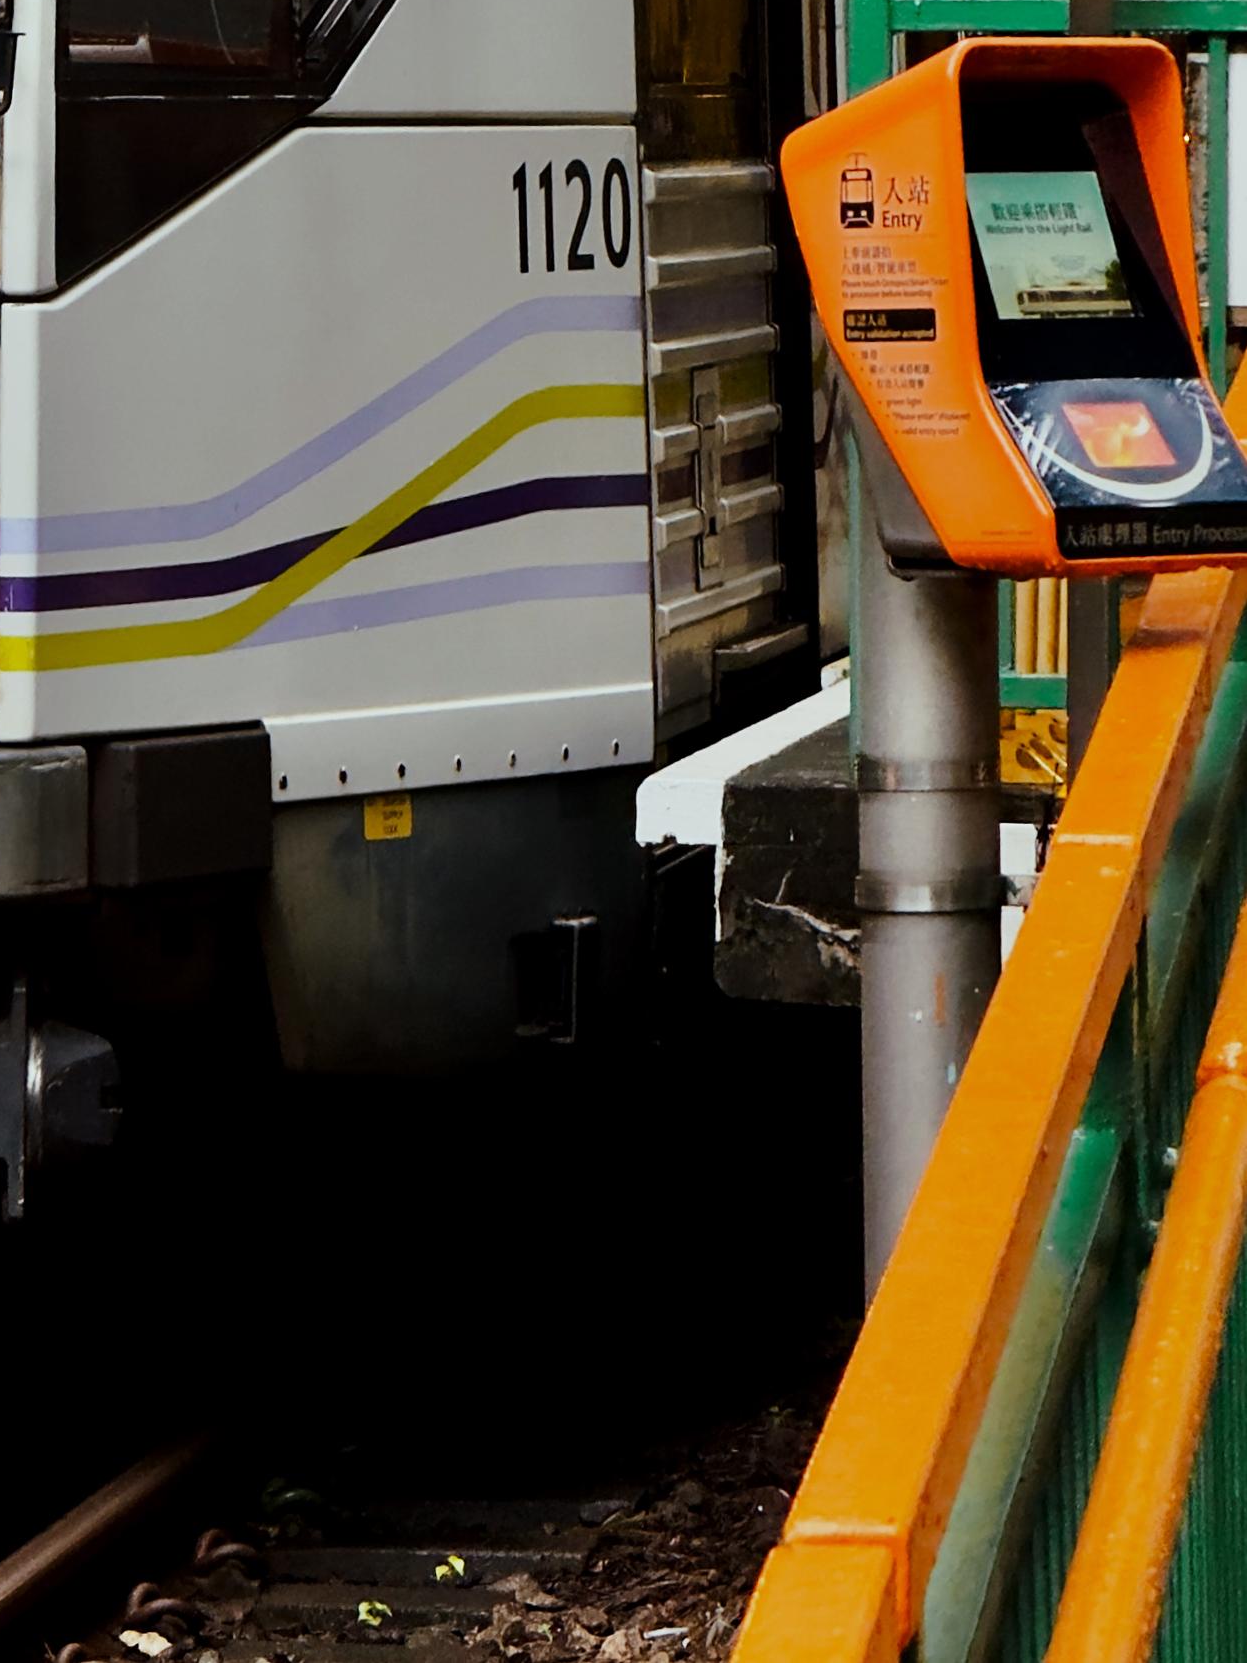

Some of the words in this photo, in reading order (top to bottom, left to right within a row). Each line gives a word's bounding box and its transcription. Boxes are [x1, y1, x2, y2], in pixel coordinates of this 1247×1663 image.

[883, 176, 930, 205] 入站
[512, 157, 631, 273] 1120
[882, 210, 923, 232] Entry
[1153, 525, 1190, 547] Entry
